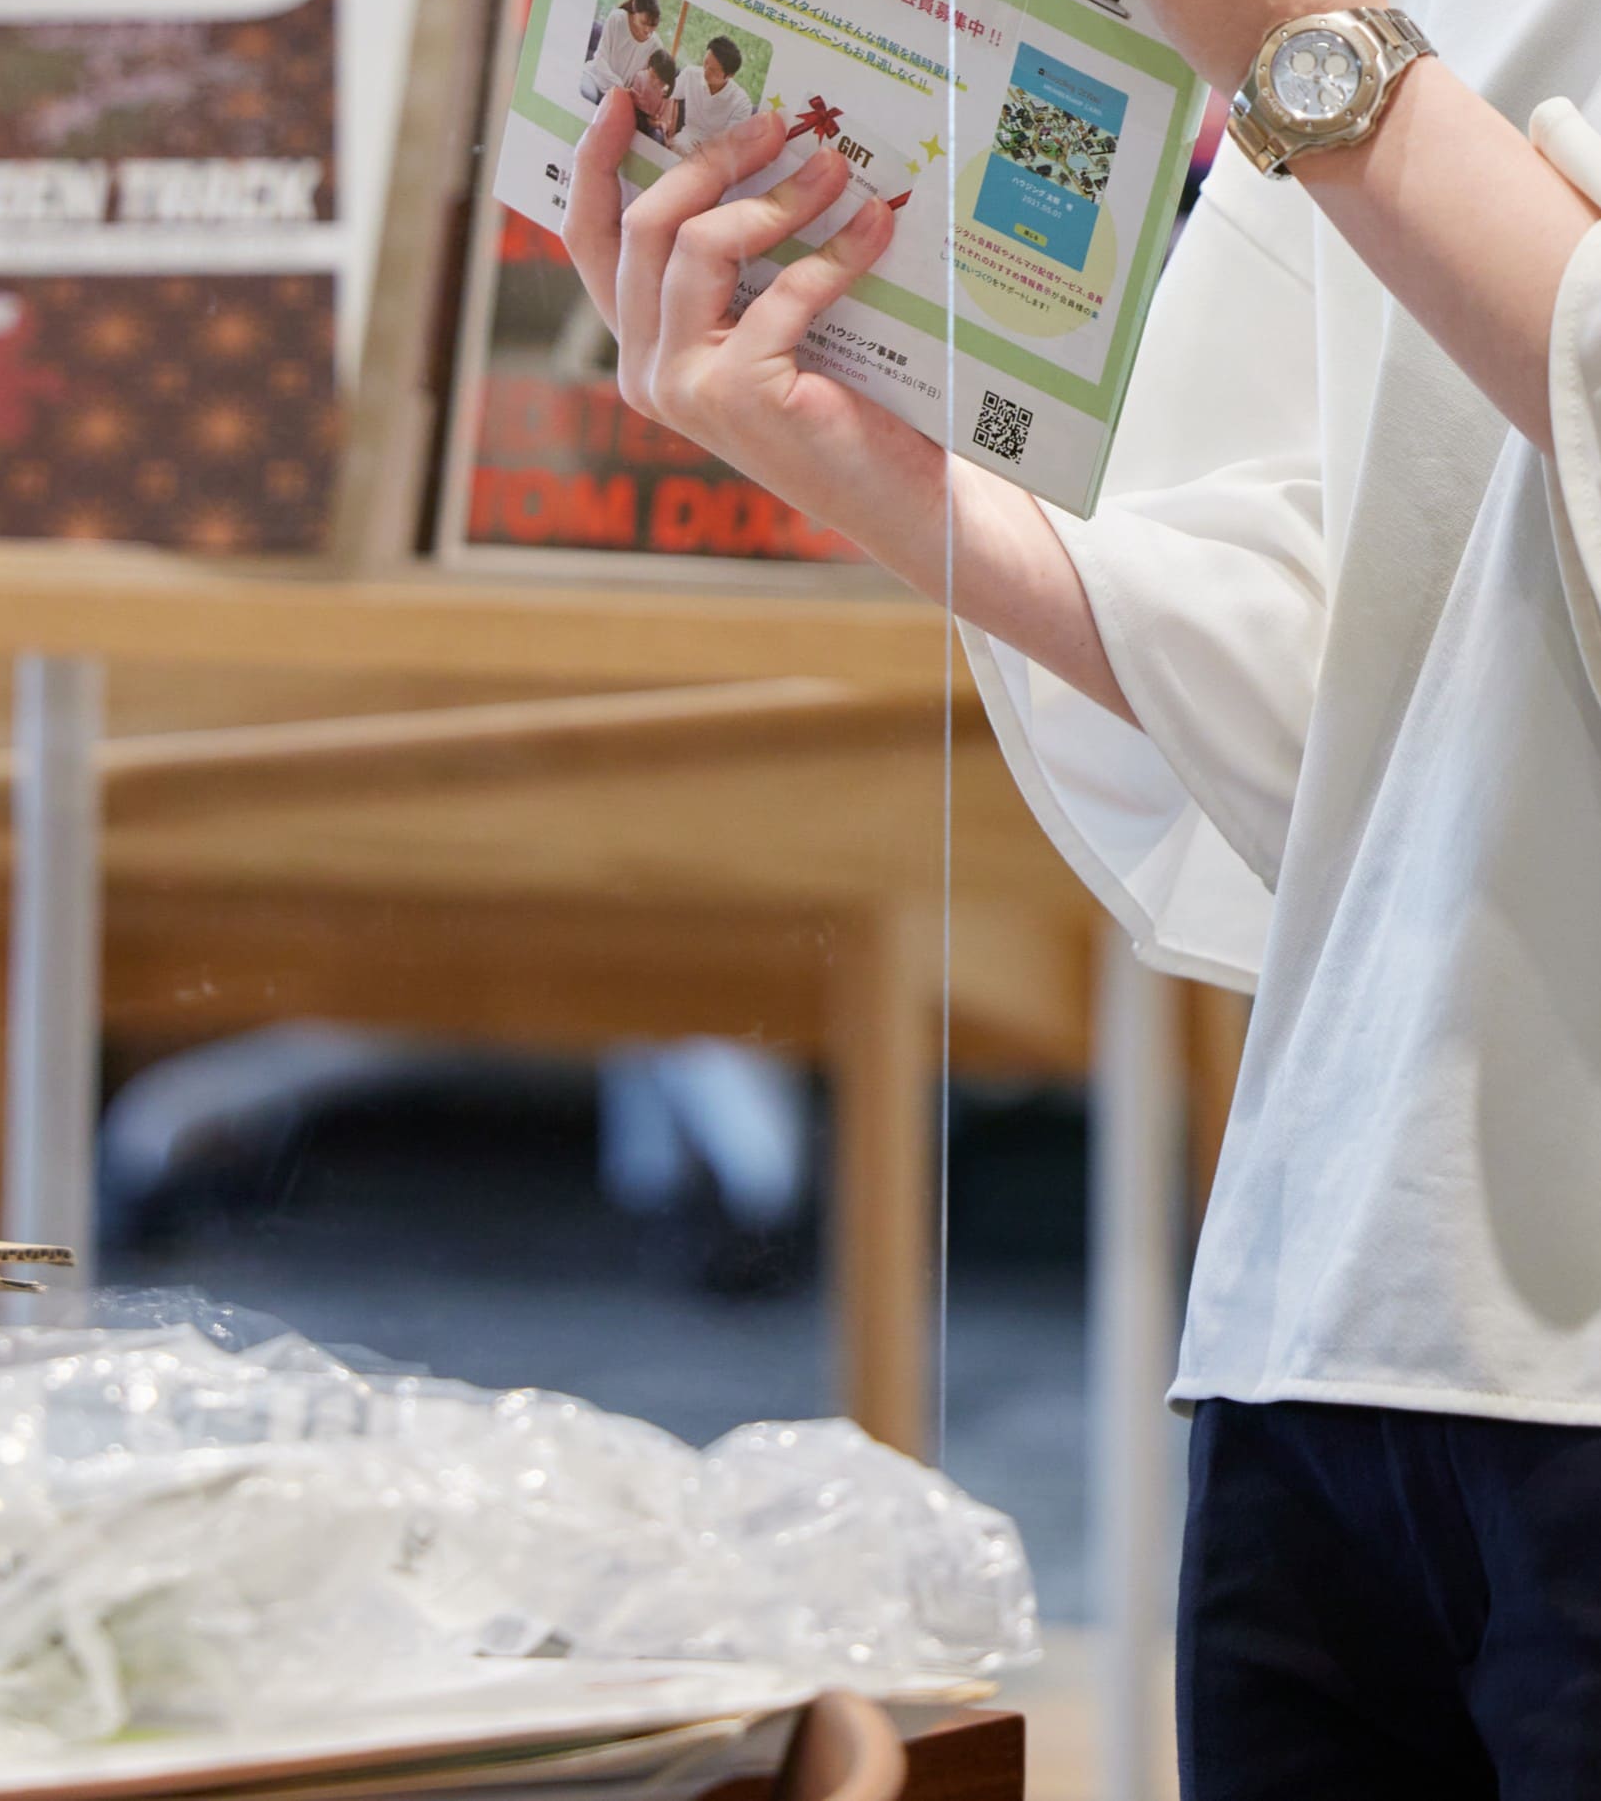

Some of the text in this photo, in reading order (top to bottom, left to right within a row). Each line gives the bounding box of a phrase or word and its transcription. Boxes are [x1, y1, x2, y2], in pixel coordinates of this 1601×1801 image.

[836, 135, 875, 170] GIFT
[116, 158, 324, 222] TRACK
[824, 323, 909, 368] ハウジング事業部
[467, 467, 638, 549] TOM
